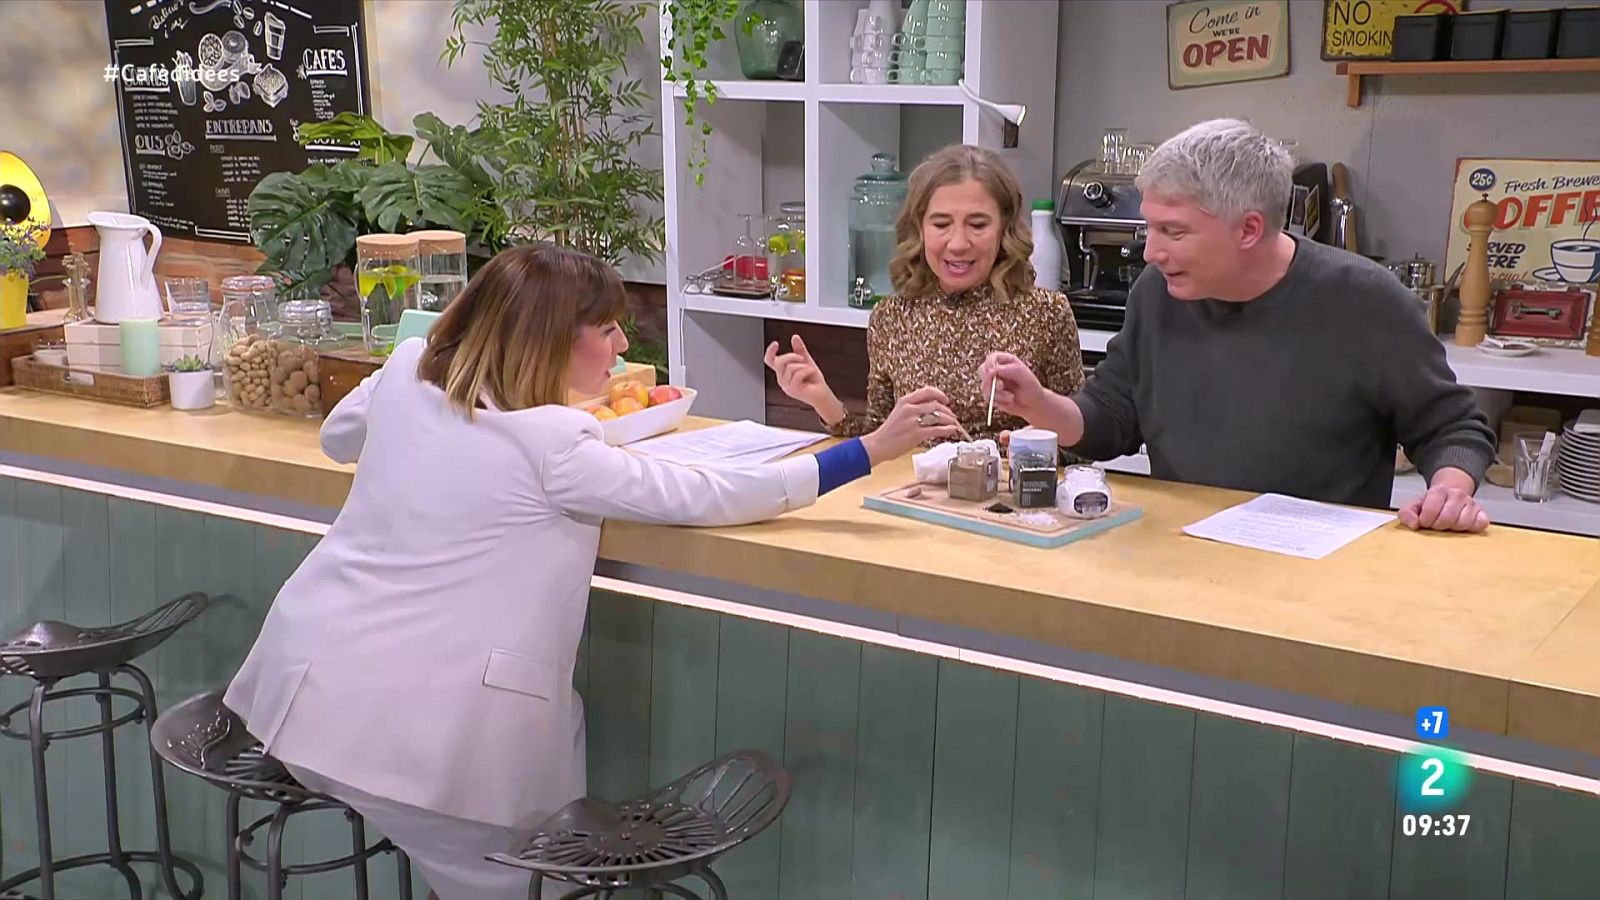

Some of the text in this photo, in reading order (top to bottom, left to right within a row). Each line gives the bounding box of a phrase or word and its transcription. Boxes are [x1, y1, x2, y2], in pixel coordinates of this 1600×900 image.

[1189, 5, 1261, 34] Come in
[1333, 0, 1371, 25] NO
[1183, 34, 1269, 68] OPEN
[205, 119, 273, 134] ENTREPANS
[135, 134, 164, 151] OUS
[1472, 172, 1494, 186] 25¢
[1504, 177, 1548, 194] Fresh
